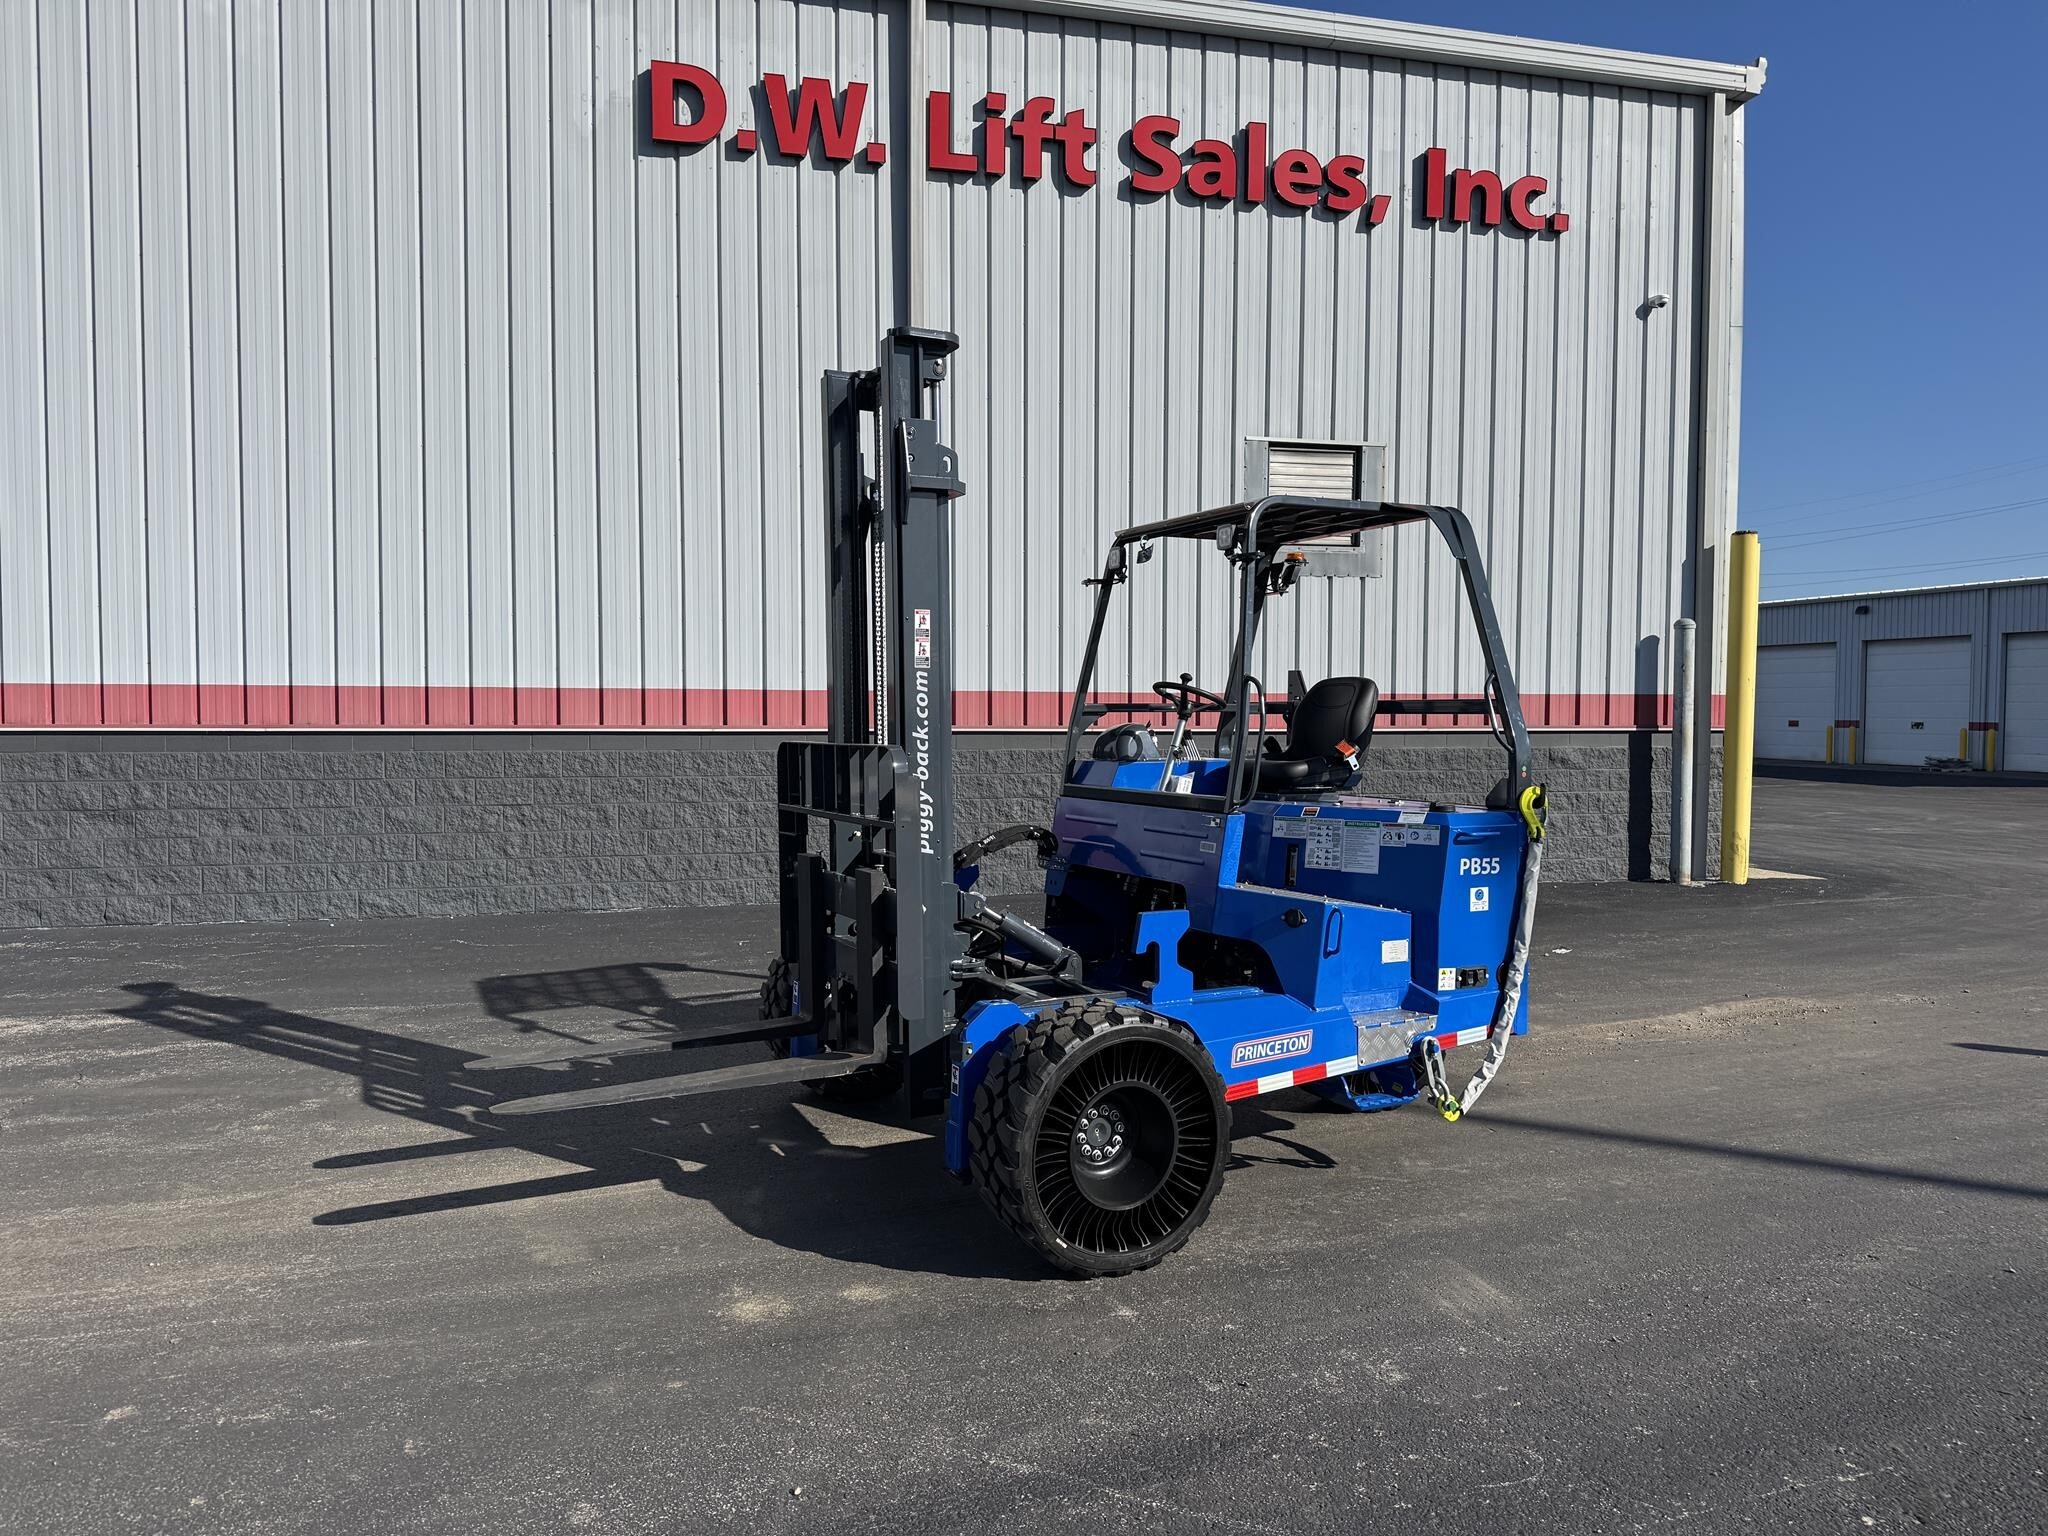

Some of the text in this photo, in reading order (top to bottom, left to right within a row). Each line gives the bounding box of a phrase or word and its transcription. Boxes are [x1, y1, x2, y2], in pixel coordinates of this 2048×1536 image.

[650, 59, 1570, 232] D.W. Lift Sales, Inc.
[912, 670, 934, 854] piggy-back.com
[1459, 857, 1501, 876] PB55
[1235, 1035, 1308, 1062] PRINCETON
